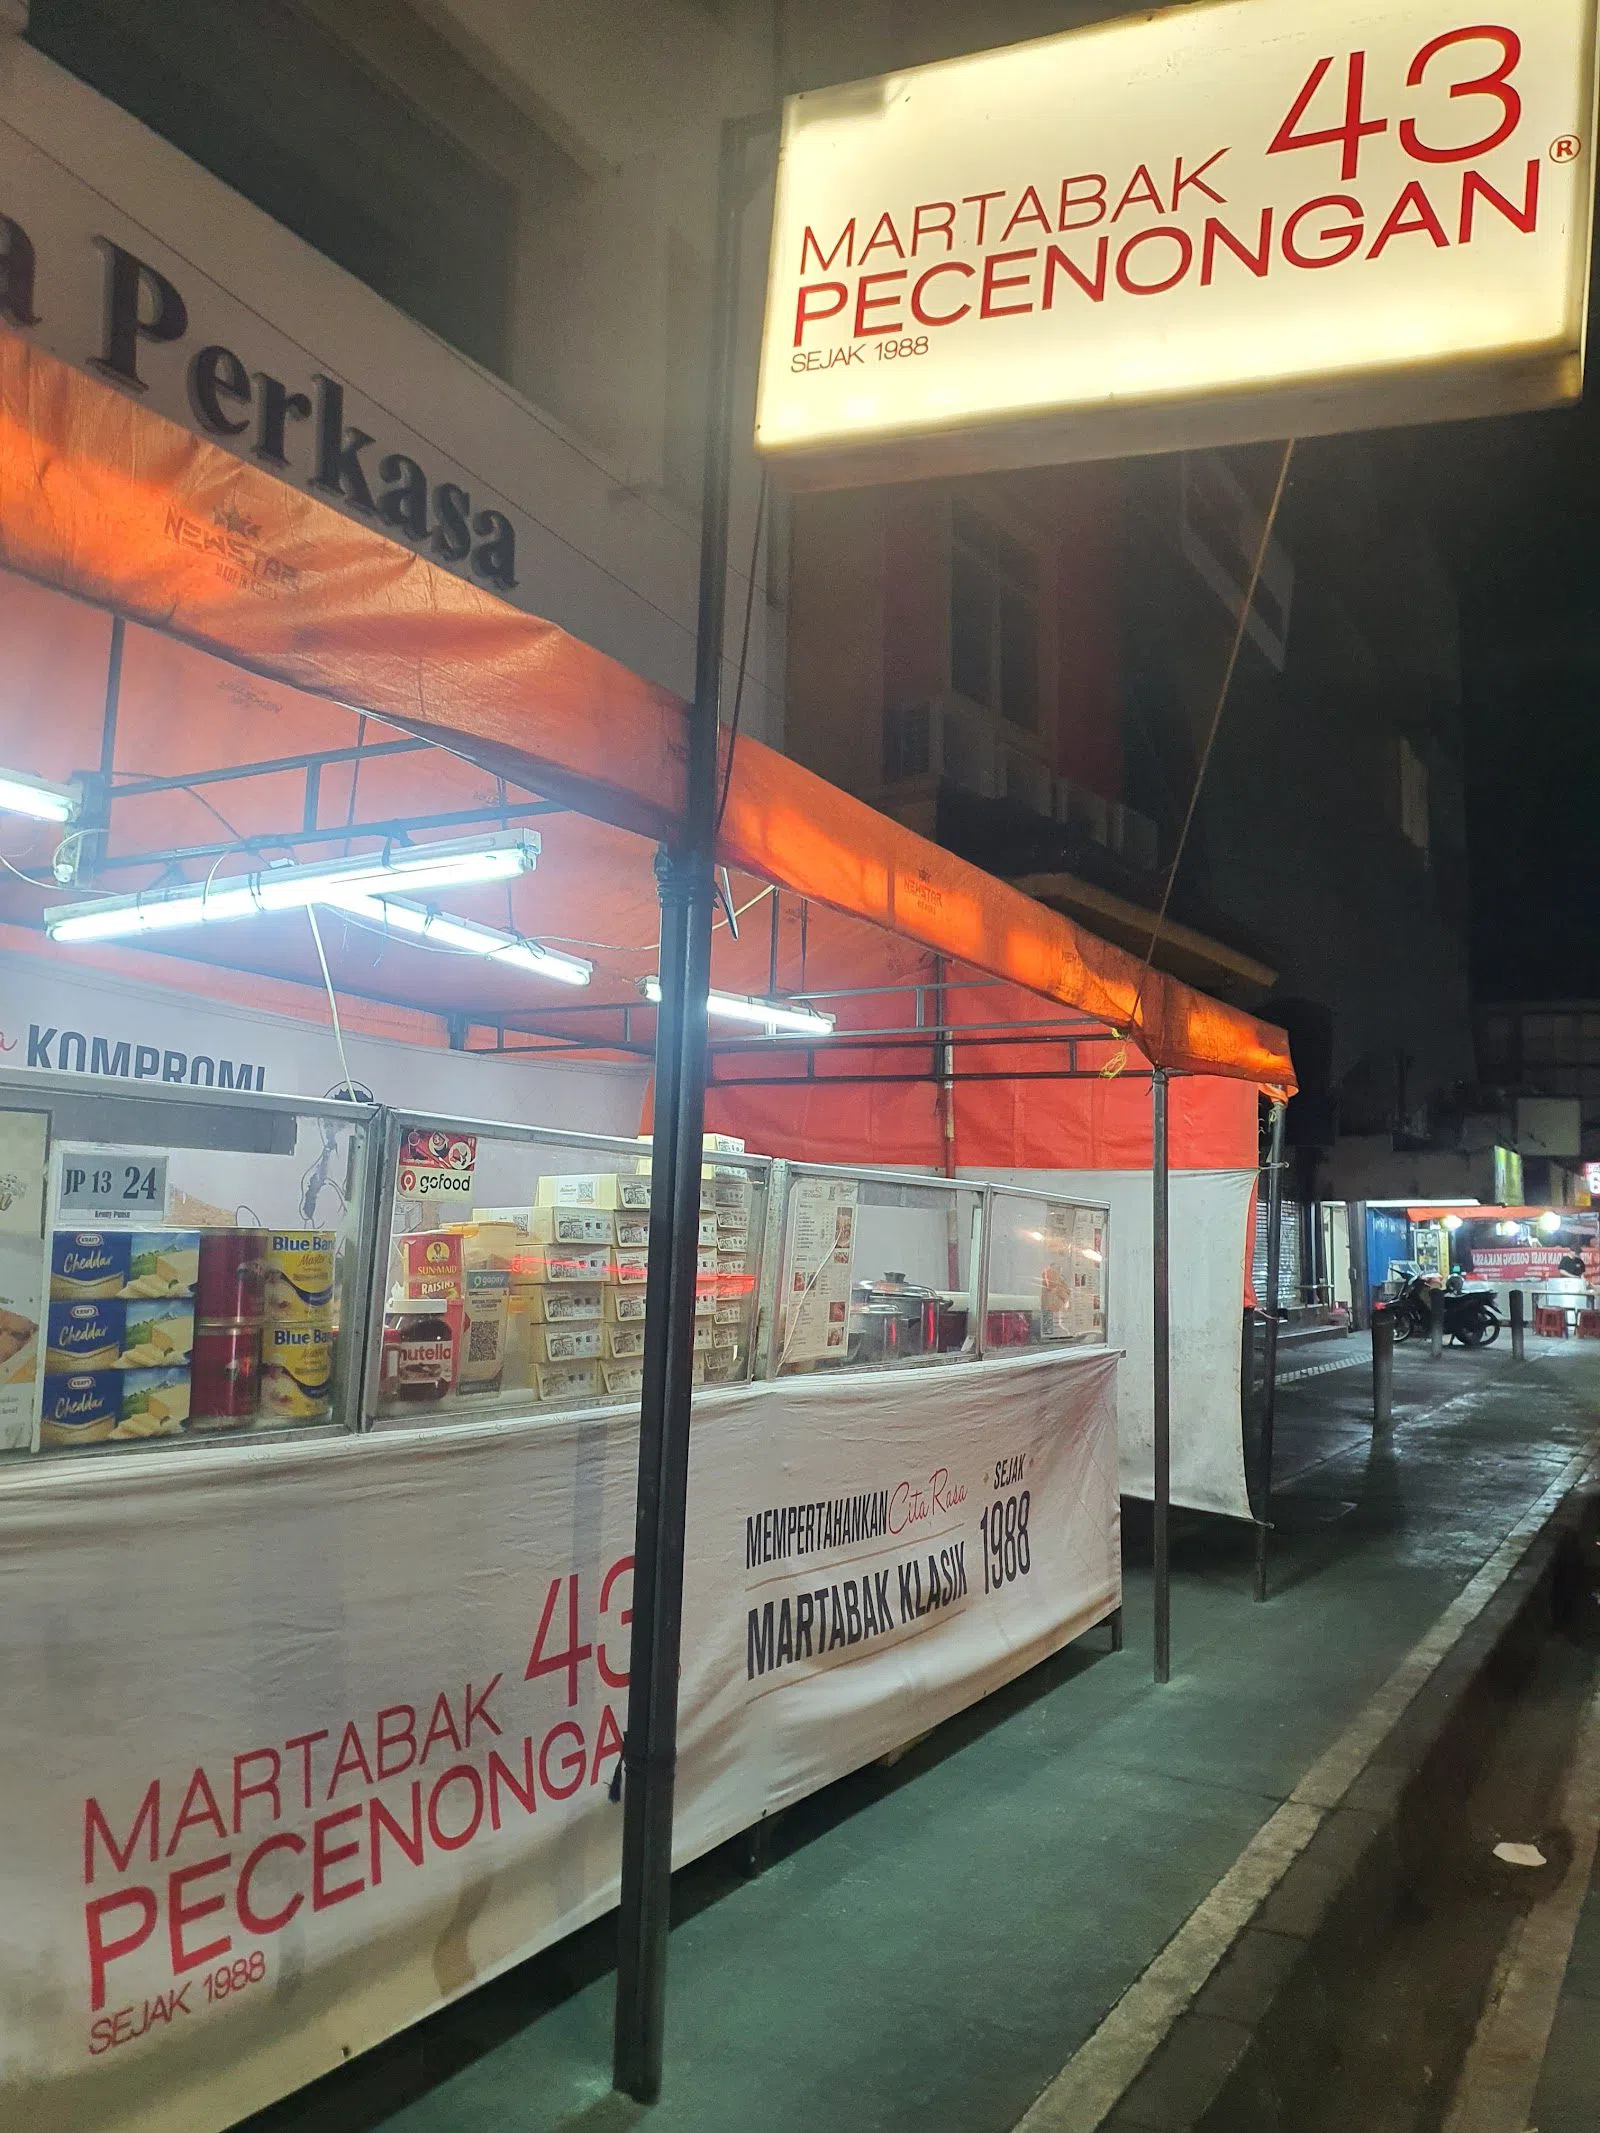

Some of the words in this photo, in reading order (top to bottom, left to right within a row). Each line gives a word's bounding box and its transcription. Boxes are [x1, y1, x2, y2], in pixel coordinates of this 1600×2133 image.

[800, 147, 1229, 276] MARTABAK
[1267, 24, 1523, 181] 43
[791, 159, 1541, 348] PECENONGAN
[791, 343, 867, 374] SEJAK
[873, 336, 929, 364] 1988
[86, 234, 519, 591] Perkasa
[27, 1023, 266, 1092] KOMPROMI
[64, 1168, 86, 1195] JP
[92, 1170, 112, 1194] 13
[123, 1166, 156, 1200] 24
[420, 1173, 471, 1193] gofood
[64, 1250, 114, 1273] Cheddar
[272, 1236, 310, 1251] Blue
[421, 1281, 455, 1296] RAISINS
[58, 1321, 108, 1346] Cheddar
[274, 1329, 310, 1345] Blue
[399, 1343, 451, 1361] nutella
[55, 1392, 104, 1418] Cheddar
[746, 1490, 888, 1569] MEMPERTAHANKAN
[888, 1481, 929, 1534] Cita
[928, 1468, 968, 1516] Rasa
[994, 1453, 1026, 1490] SEJAK
[748, 1569, 894, 1681] MARTABAK
[898, 1541, 967, 1624] KLASIK
[980, 1490, 1031, 1595] 1988
[84, 1672, 503, 1885] MARTABAK
[85, 1704, 626, 2013] PECENONGA
[89, 1981, 192, 2056] SEJAK
[202, 1951, 266, 2004] 1988
